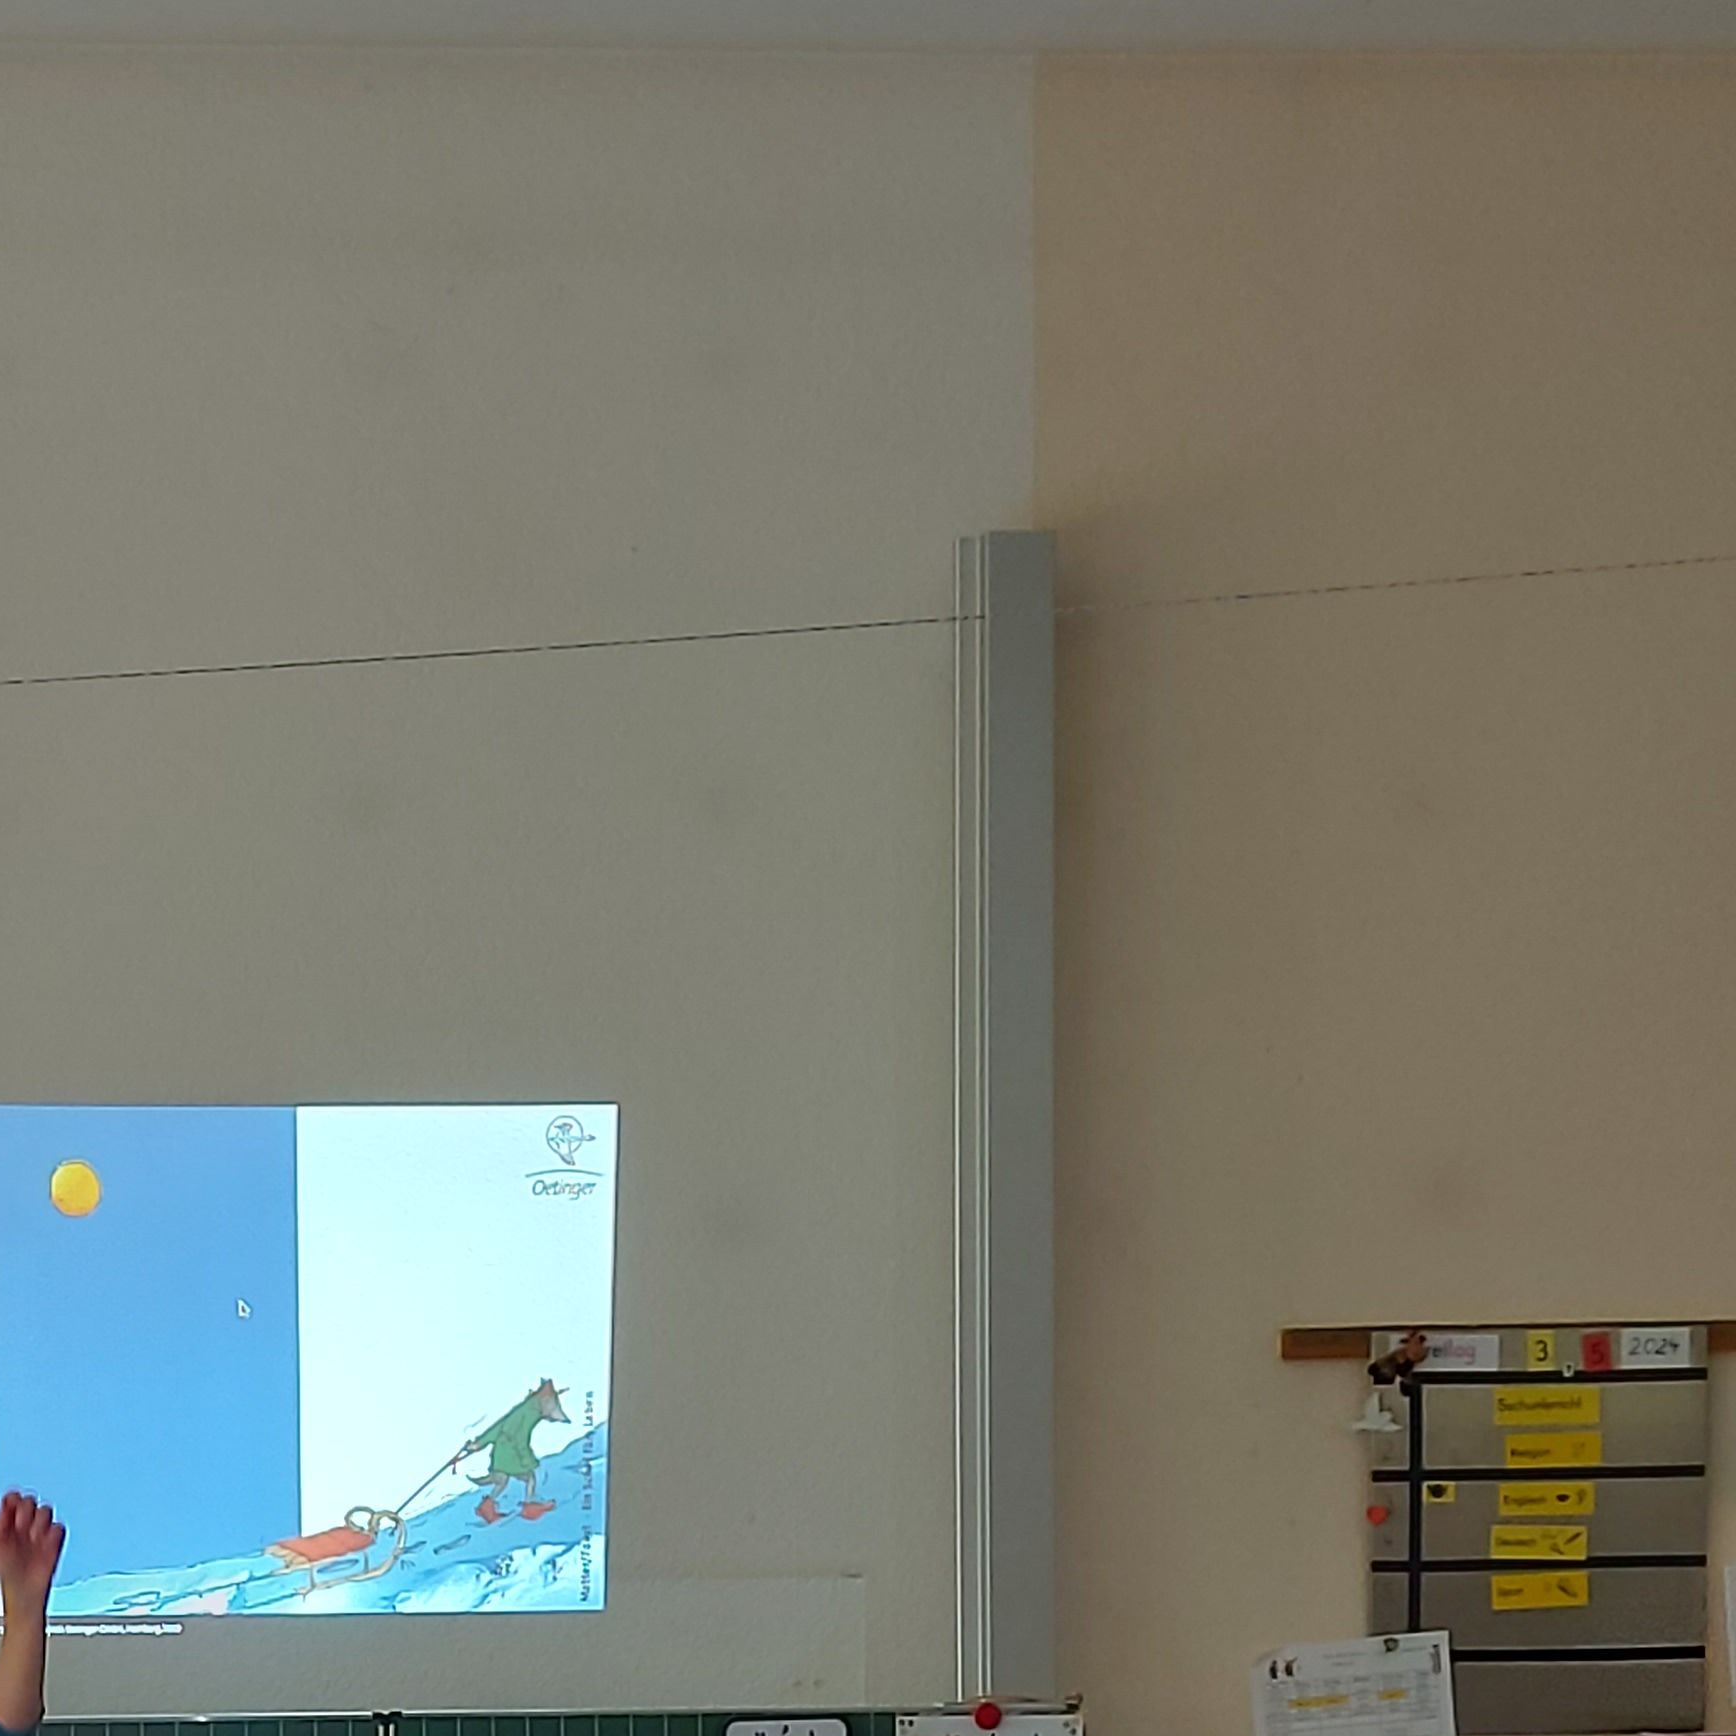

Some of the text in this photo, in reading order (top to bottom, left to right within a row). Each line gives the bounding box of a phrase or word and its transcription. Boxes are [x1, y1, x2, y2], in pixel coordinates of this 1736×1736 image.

[532, 1179, 597, 1201] Oetinger
[1535, 1339, 1549, 1363] 3
[1591, 1341, 1605, 1364] 5
[1628, 1336, 1680, 1356] 2024
